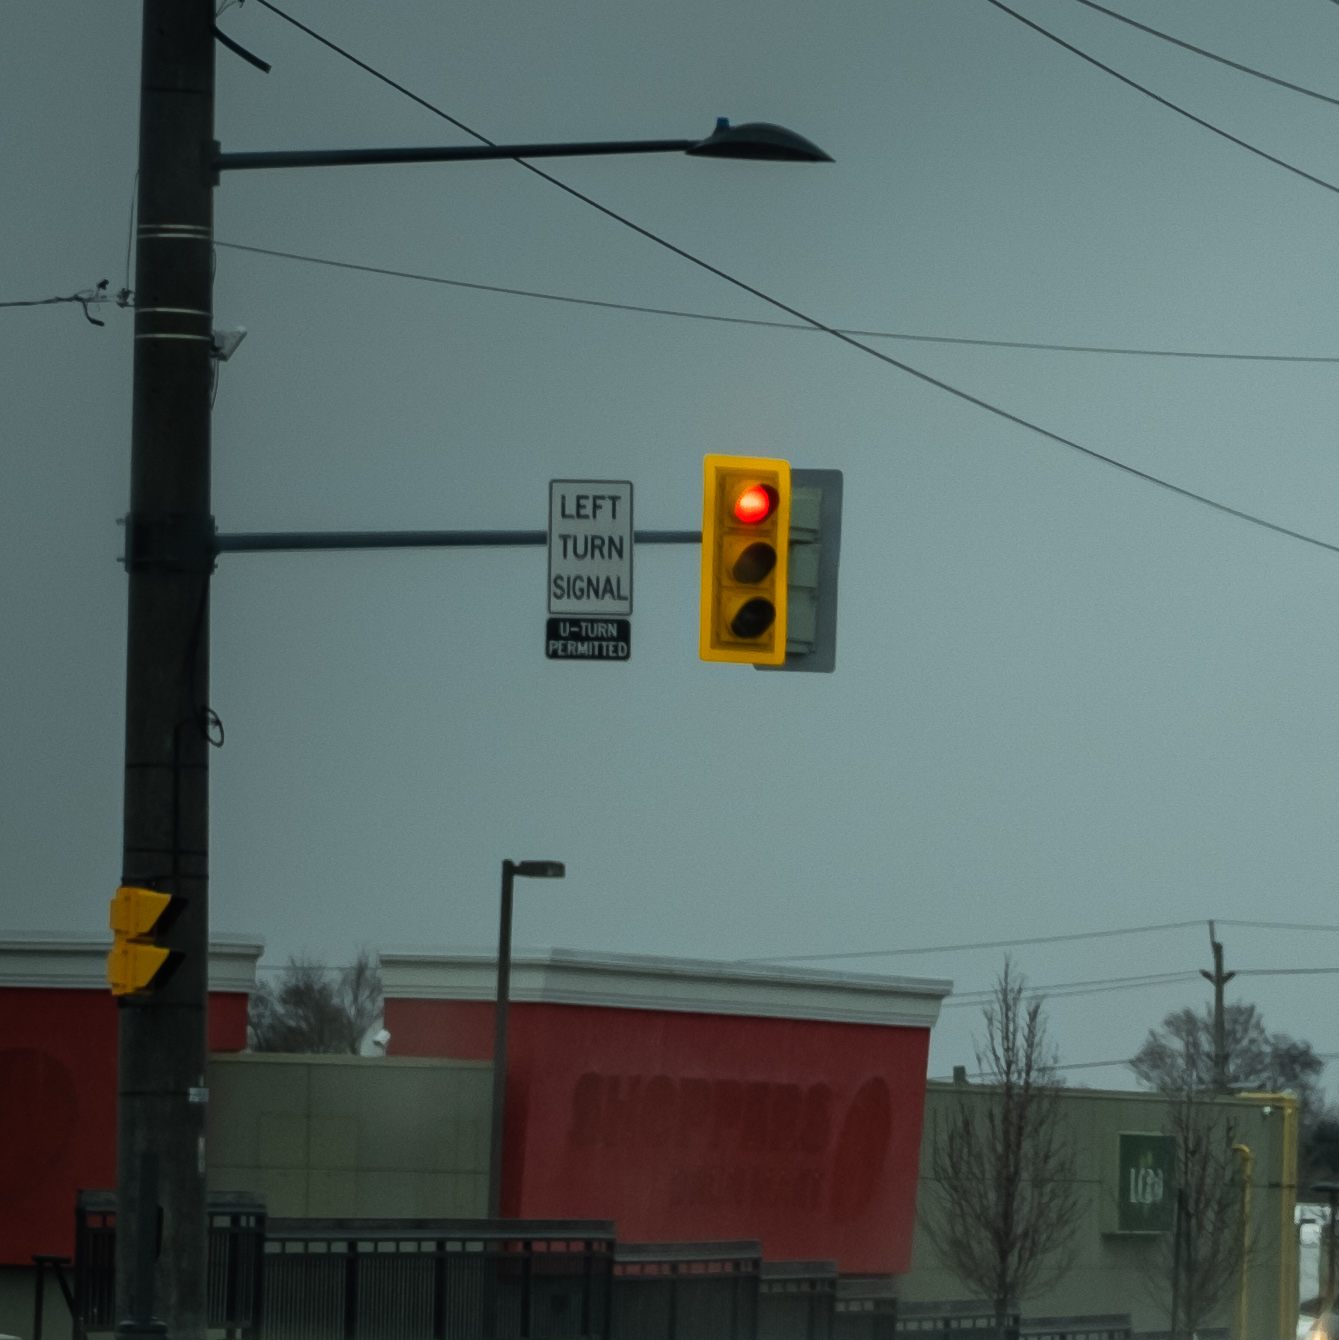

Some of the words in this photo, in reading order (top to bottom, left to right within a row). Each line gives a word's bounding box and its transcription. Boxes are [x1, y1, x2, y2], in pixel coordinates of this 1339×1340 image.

[559, 494, 622, 520] LEFT
[558, 534, 625, 561] TURN
[552, 573, 629, 601] SIGNAL
[559, 622, 618, 638] U-TURN
[548, 640, 628, 657] PERMITTED
